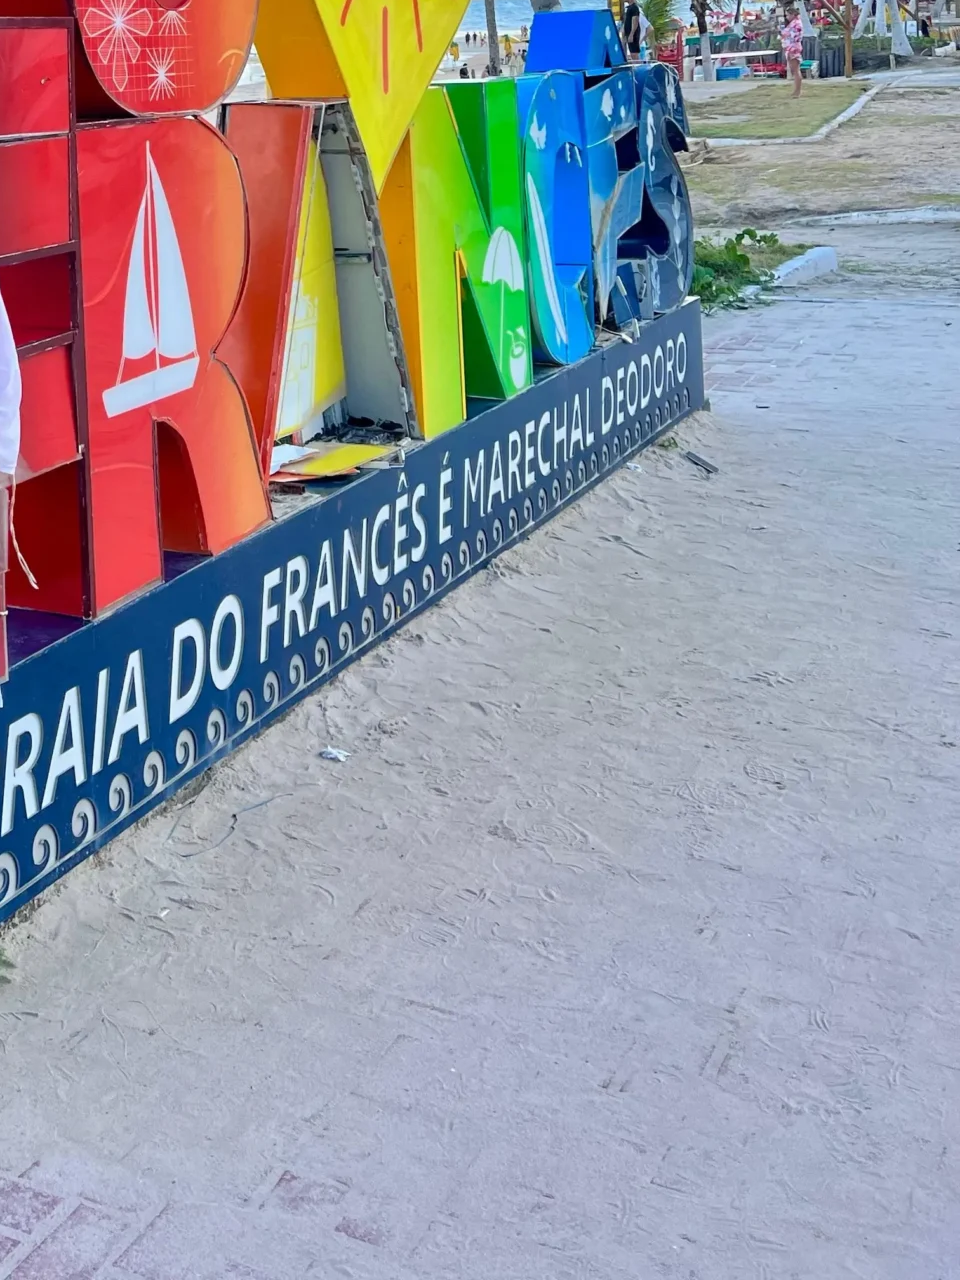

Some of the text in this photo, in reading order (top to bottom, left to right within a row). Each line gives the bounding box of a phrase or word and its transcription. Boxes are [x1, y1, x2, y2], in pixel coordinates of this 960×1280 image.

[169, 594, 246, 724] DO
[259, 472, 427, 664] FRANCÊS
[439, 451, 453, 545] É
[463, 393, 596, 528] MARECHAL
[601, 331, 687, 436] DEODORO
